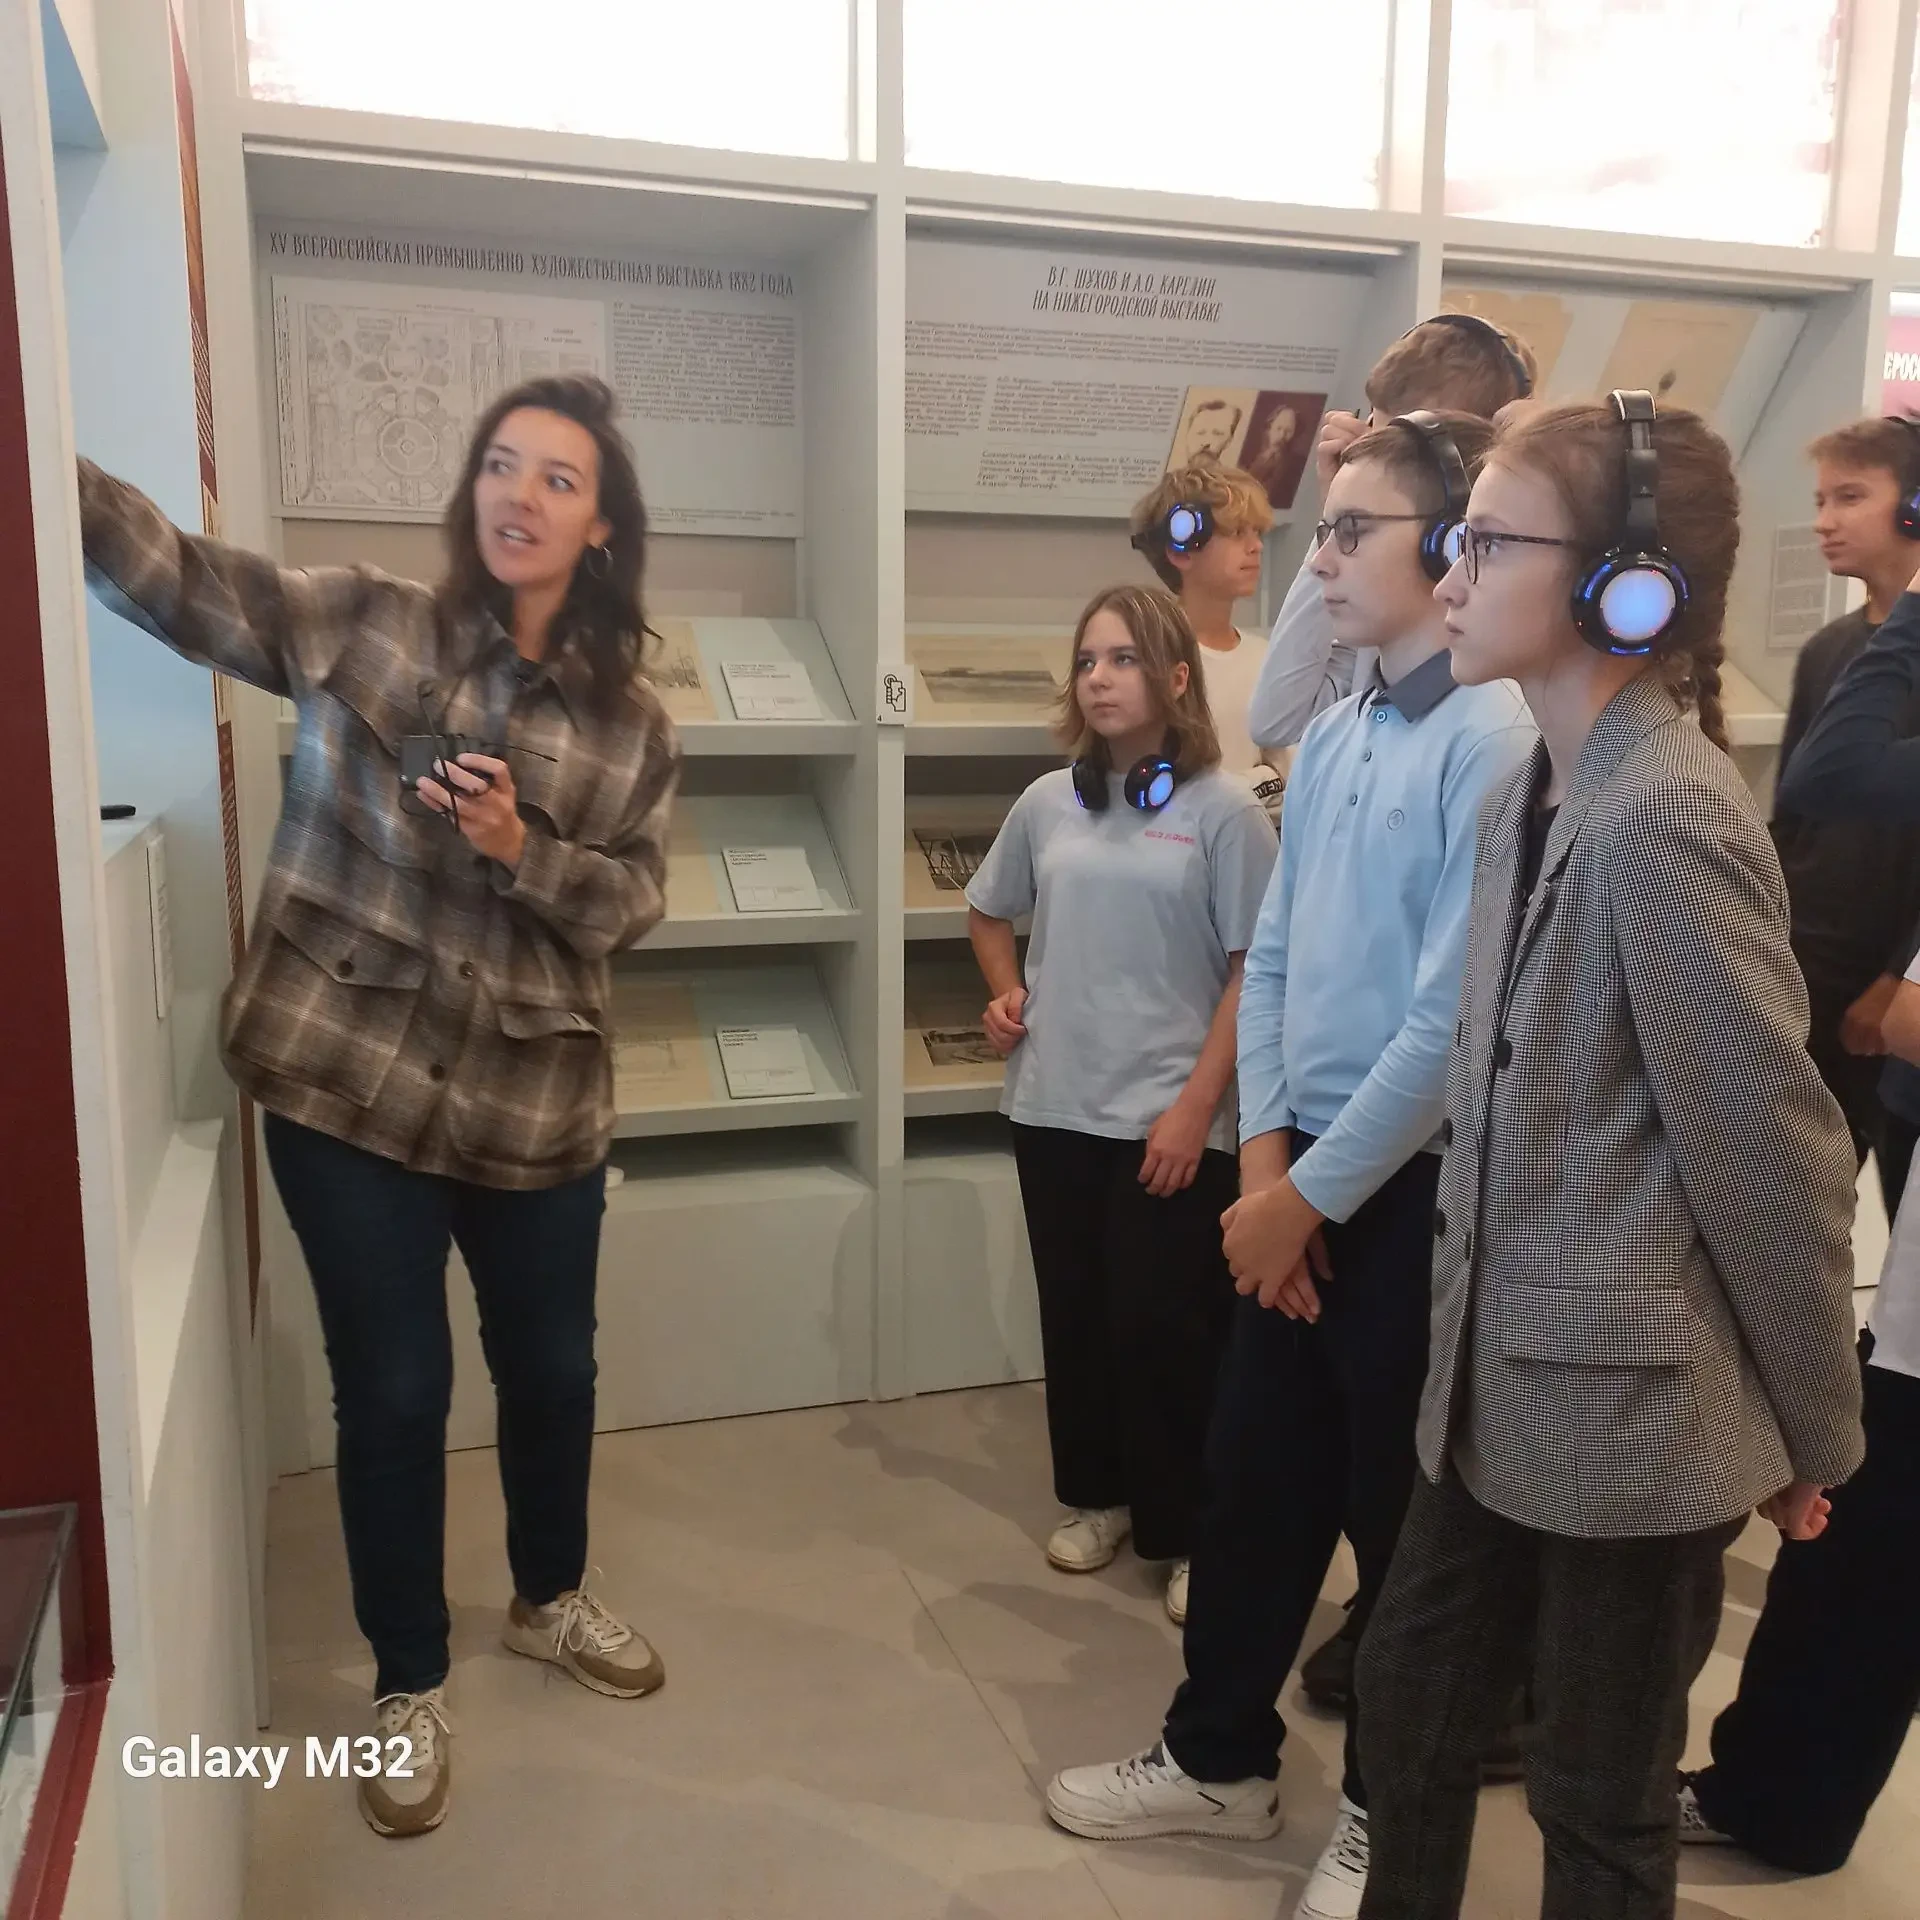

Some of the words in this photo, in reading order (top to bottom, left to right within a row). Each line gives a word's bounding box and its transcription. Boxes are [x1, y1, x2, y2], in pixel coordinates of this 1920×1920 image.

[292, 234, 411, 265] ВСЕРОССИЙСКАЯ
[531, 253, 651, 285] ХУДОЖЕСТВЕННАЯ
[657, 263, 723, 290] ВЫСТАВКА
[730, 271, 756, 293] 1882
[761, 271, 794, 300] ГОДА
[1074, 268, 1118, 291] ШУХОВ
[1119, 271, 1132, 292] И
[1159, 274, 1217, 299] КАРЕЛИН
[1032, 289, 1049, 311] НА
[1053, 290, 1158, 319] НИЖЕГОРОДСКОЙ
[1159, 298, 1224, 324] ВЫСТАВКЕ
